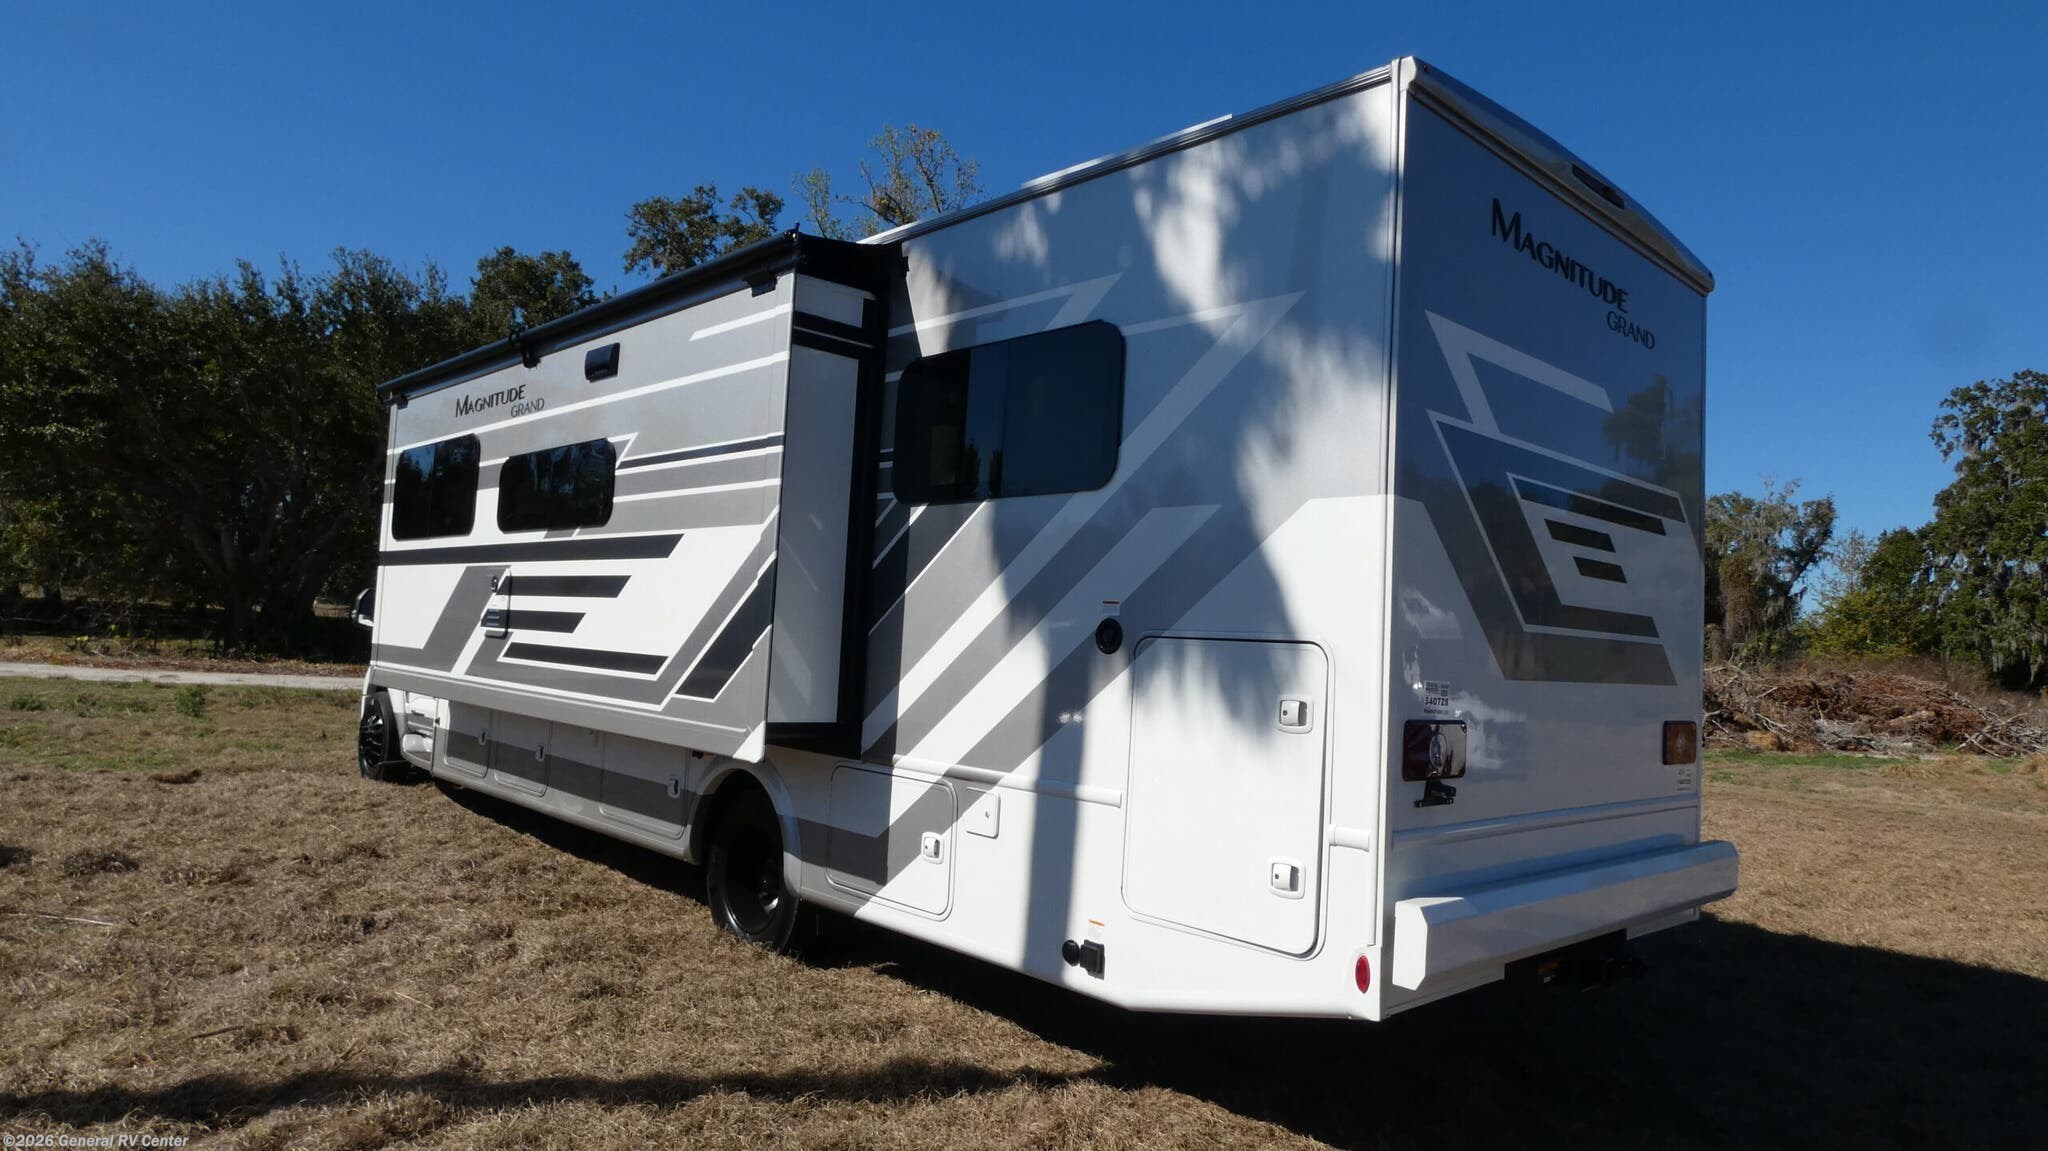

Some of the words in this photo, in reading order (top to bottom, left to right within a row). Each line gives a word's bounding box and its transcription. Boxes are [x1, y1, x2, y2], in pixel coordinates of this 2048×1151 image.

[1492, 197, 1628, 313] MAGNITUDE
[1606, 311, 1655, 349] GRAND
[455, 384, 526, 418] MAGNITUDE
[510, 397, 545, 418] GRAND
